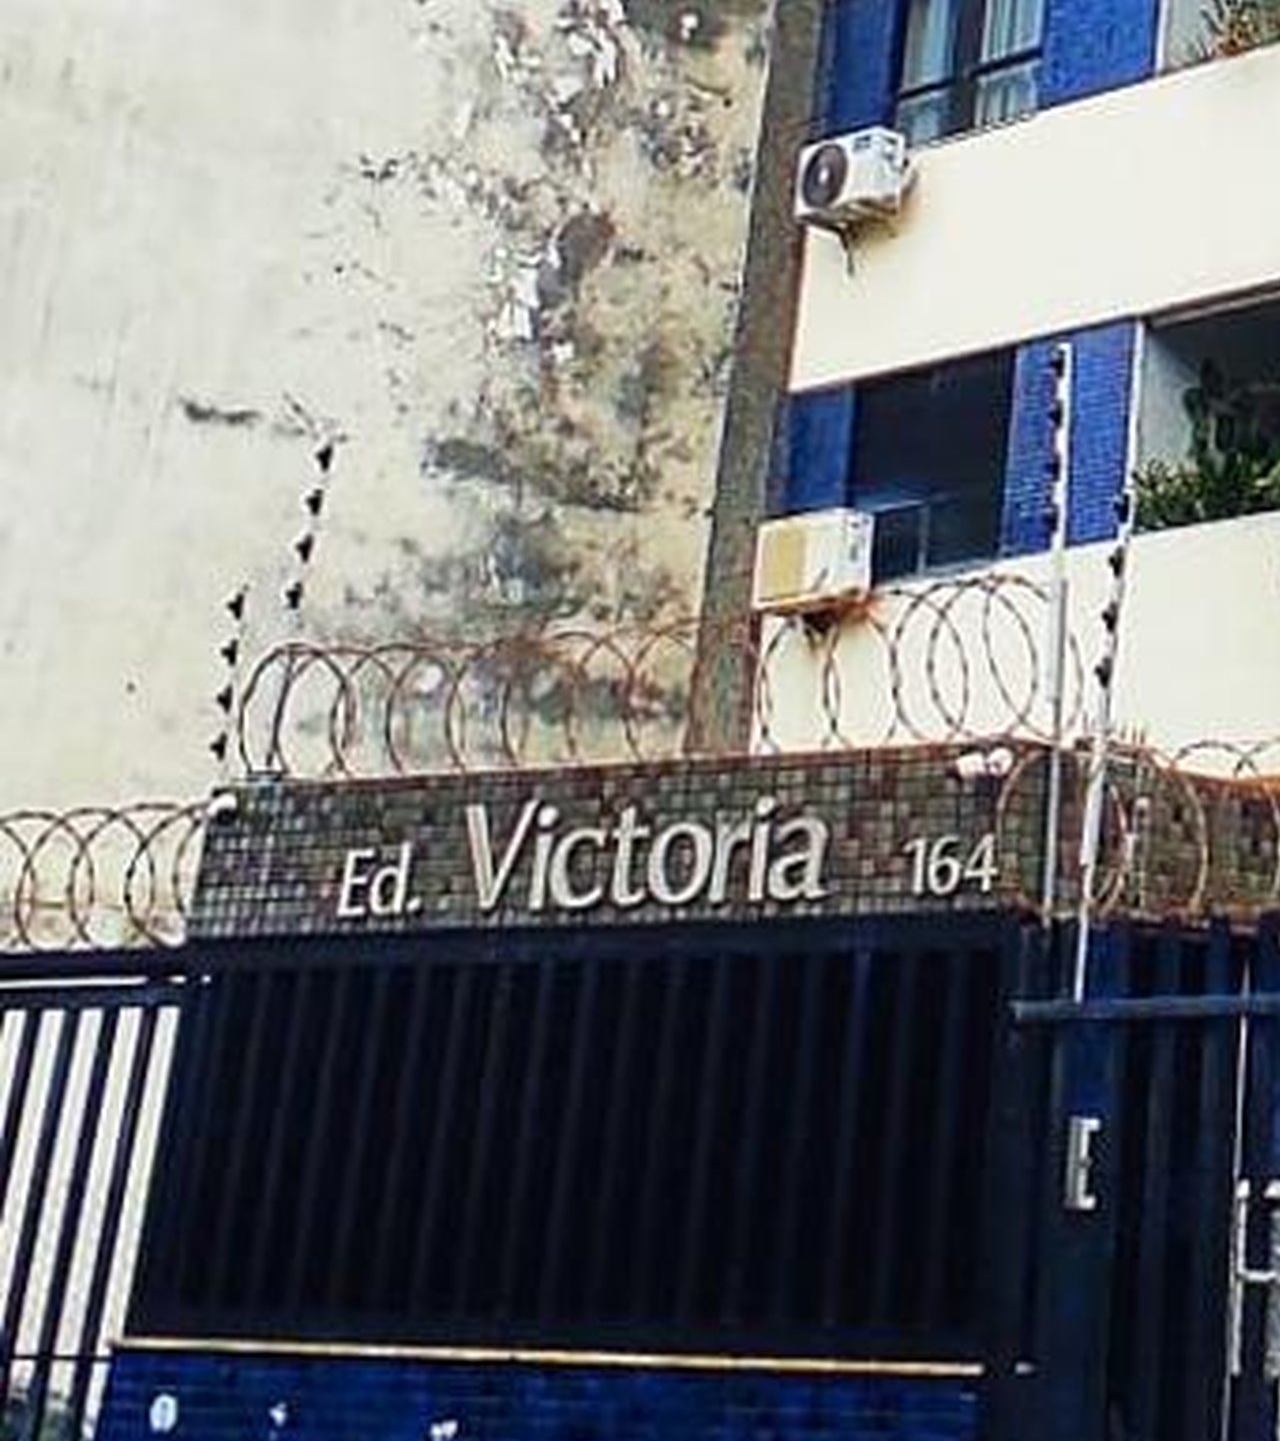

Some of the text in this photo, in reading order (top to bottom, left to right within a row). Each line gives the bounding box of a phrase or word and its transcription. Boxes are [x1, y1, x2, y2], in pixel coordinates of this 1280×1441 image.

[337, 795, 998, 917] Ed. Victoria 164
